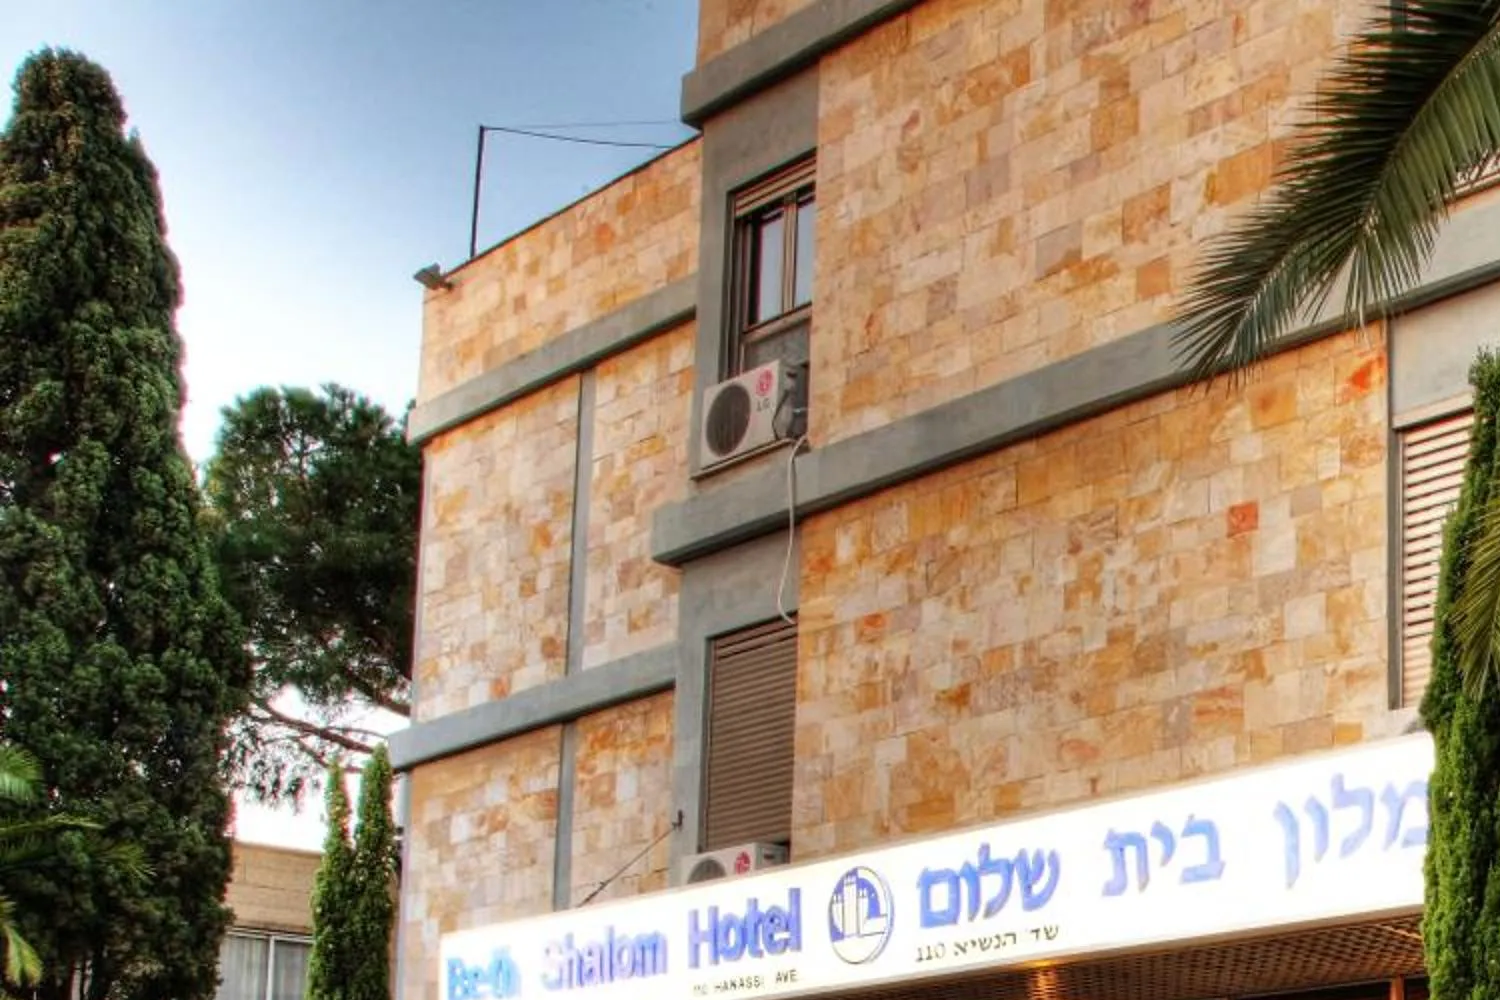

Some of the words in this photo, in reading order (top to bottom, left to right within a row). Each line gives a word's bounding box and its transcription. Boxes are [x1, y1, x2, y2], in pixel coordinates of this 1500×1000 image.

[1102, 813, 1226, 896] בית
[1273, 773, 1428, 890] מלון
[916, 843, 1060, 928] שלום
[541, 925, 669, 990] Shalom
[688, 887, 802, 969] Hotel
[775, 969, 798, 984] AVE
[915, 942, 946, 963] 110
[953, 931, 1018, 957] הנשיא
